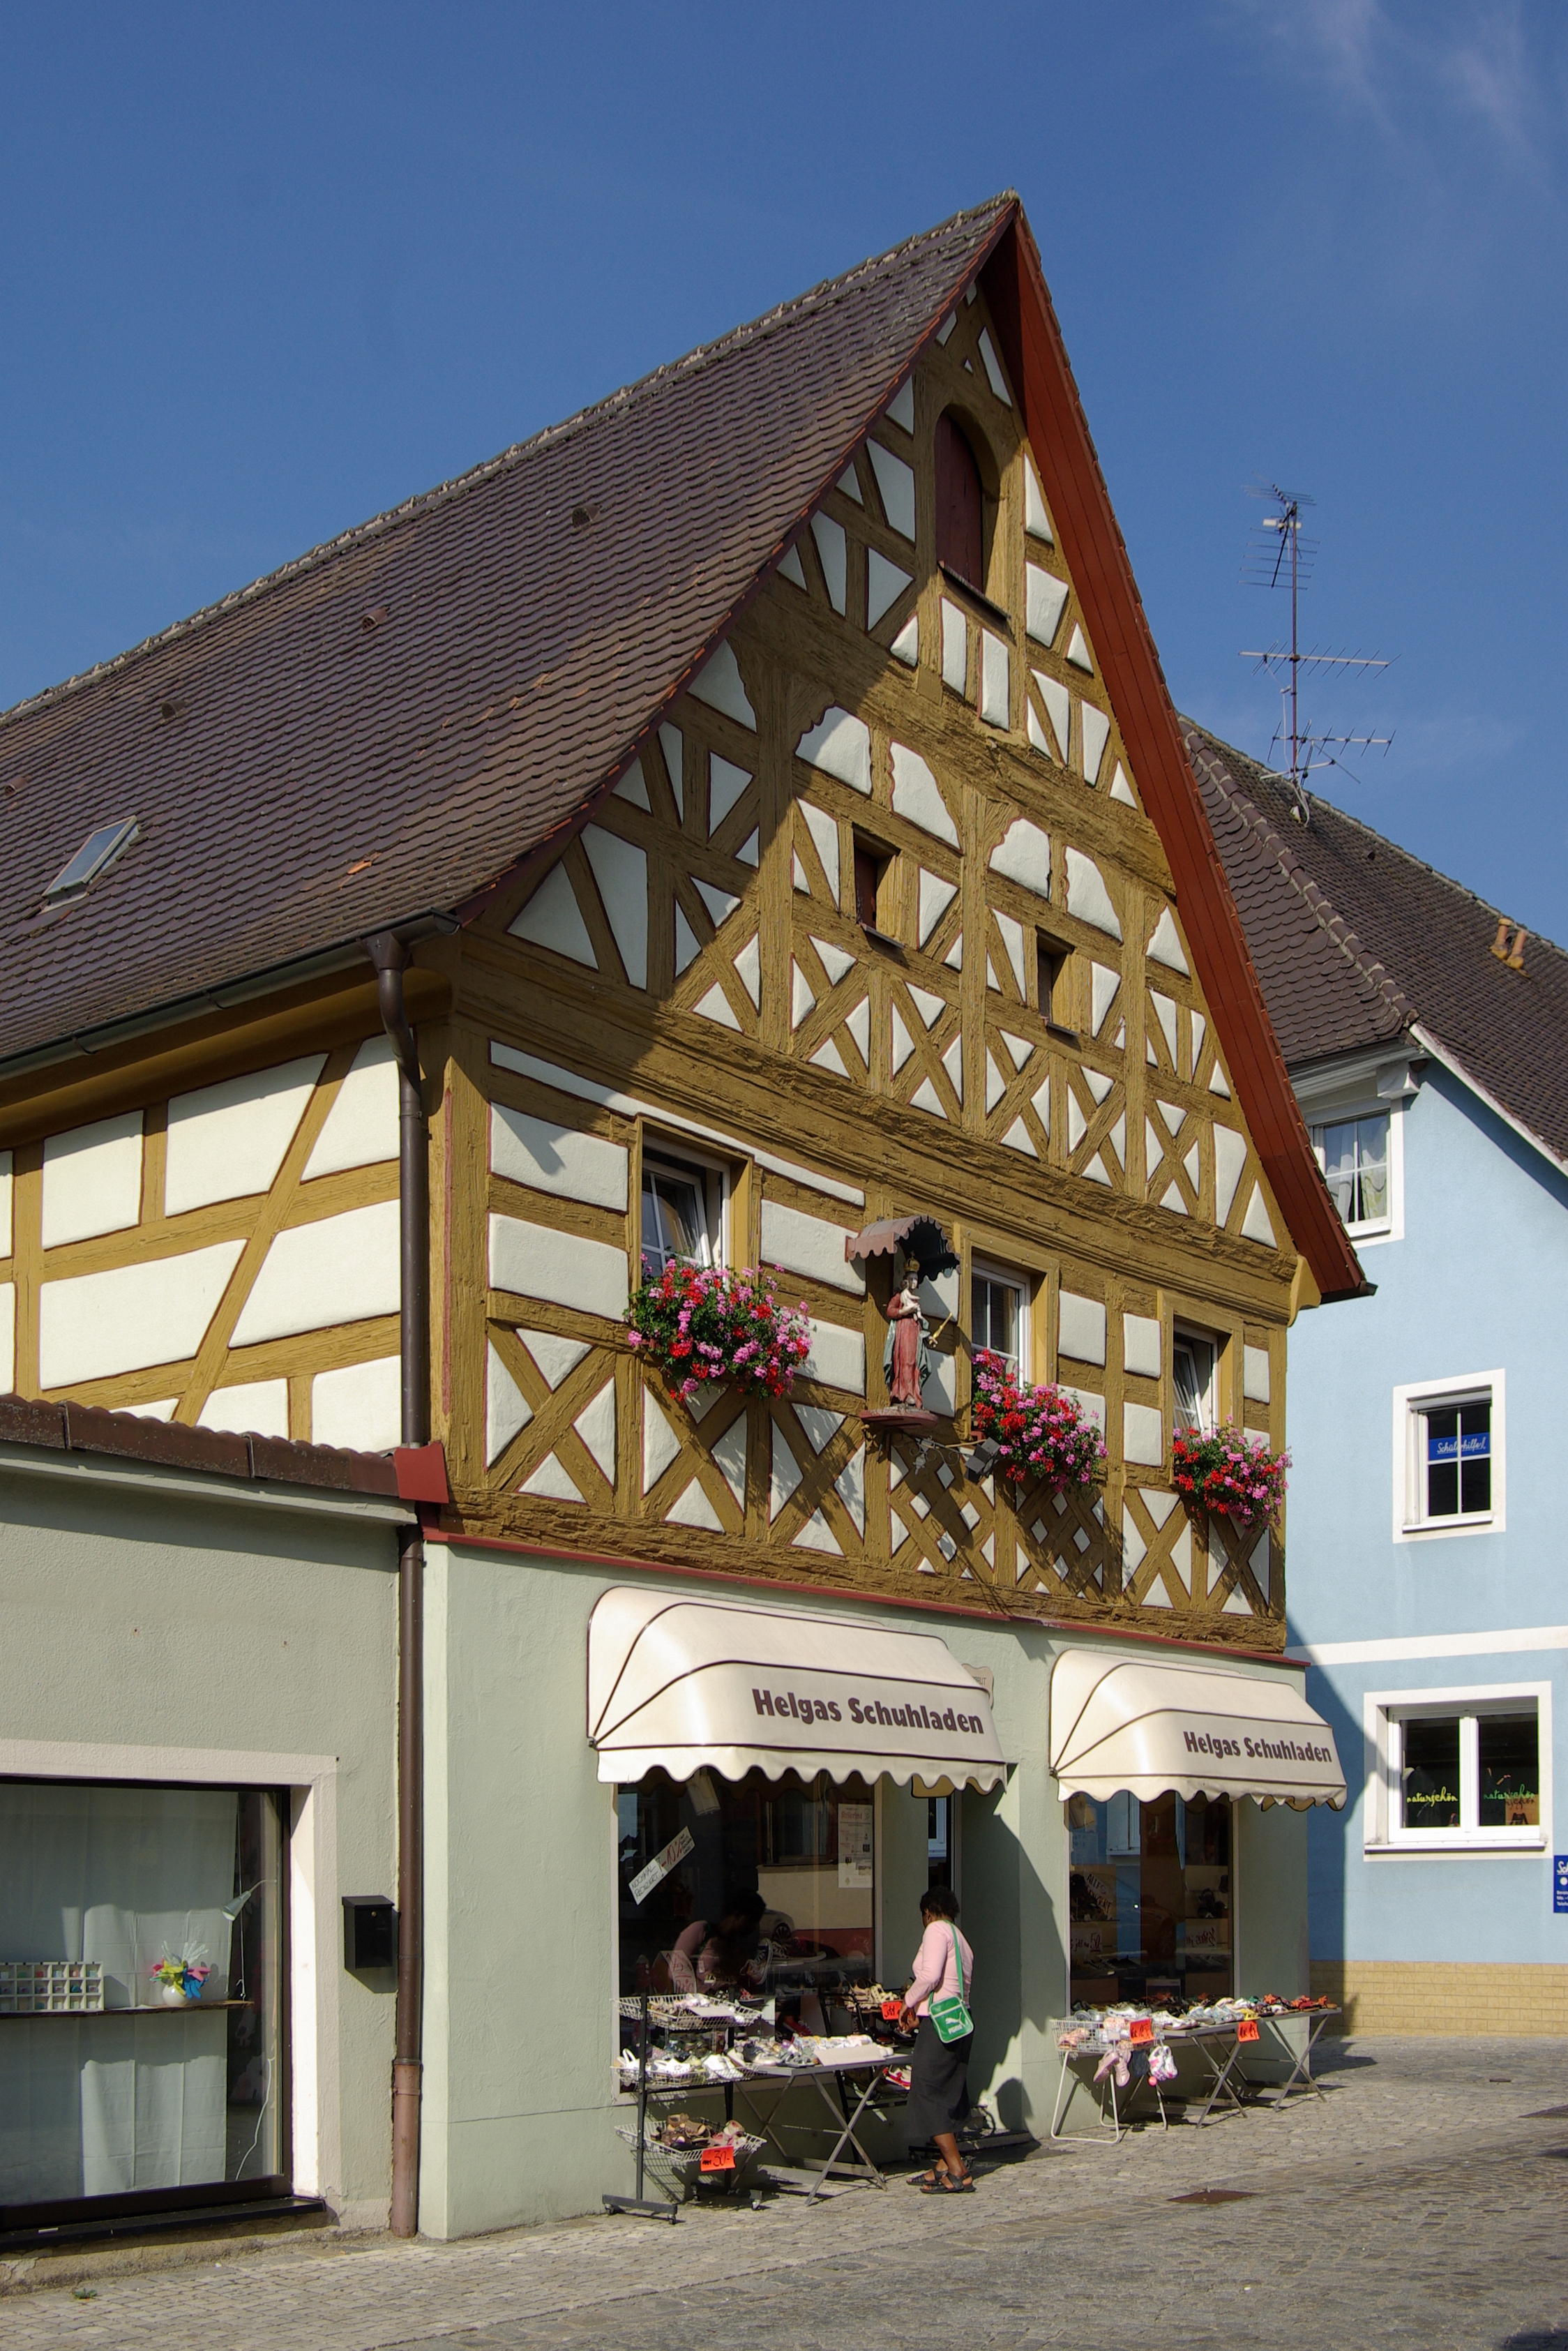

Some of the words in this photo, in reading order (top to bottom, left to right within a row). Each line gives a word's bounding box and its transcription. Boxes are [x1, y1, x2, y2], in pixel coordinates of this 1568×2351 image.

[752, 1688, 842, 1725] Helgas
[847, 1697, 985, 1734] Schuhladen
[1183, 1731, 1241, 1759] Helgas
[1244, 1736, 1332, 1763] Schuhladen
[1406, 1786, 1458, 1807] naturschön
[631, 1865, 656, 1890] NOCHMAL
